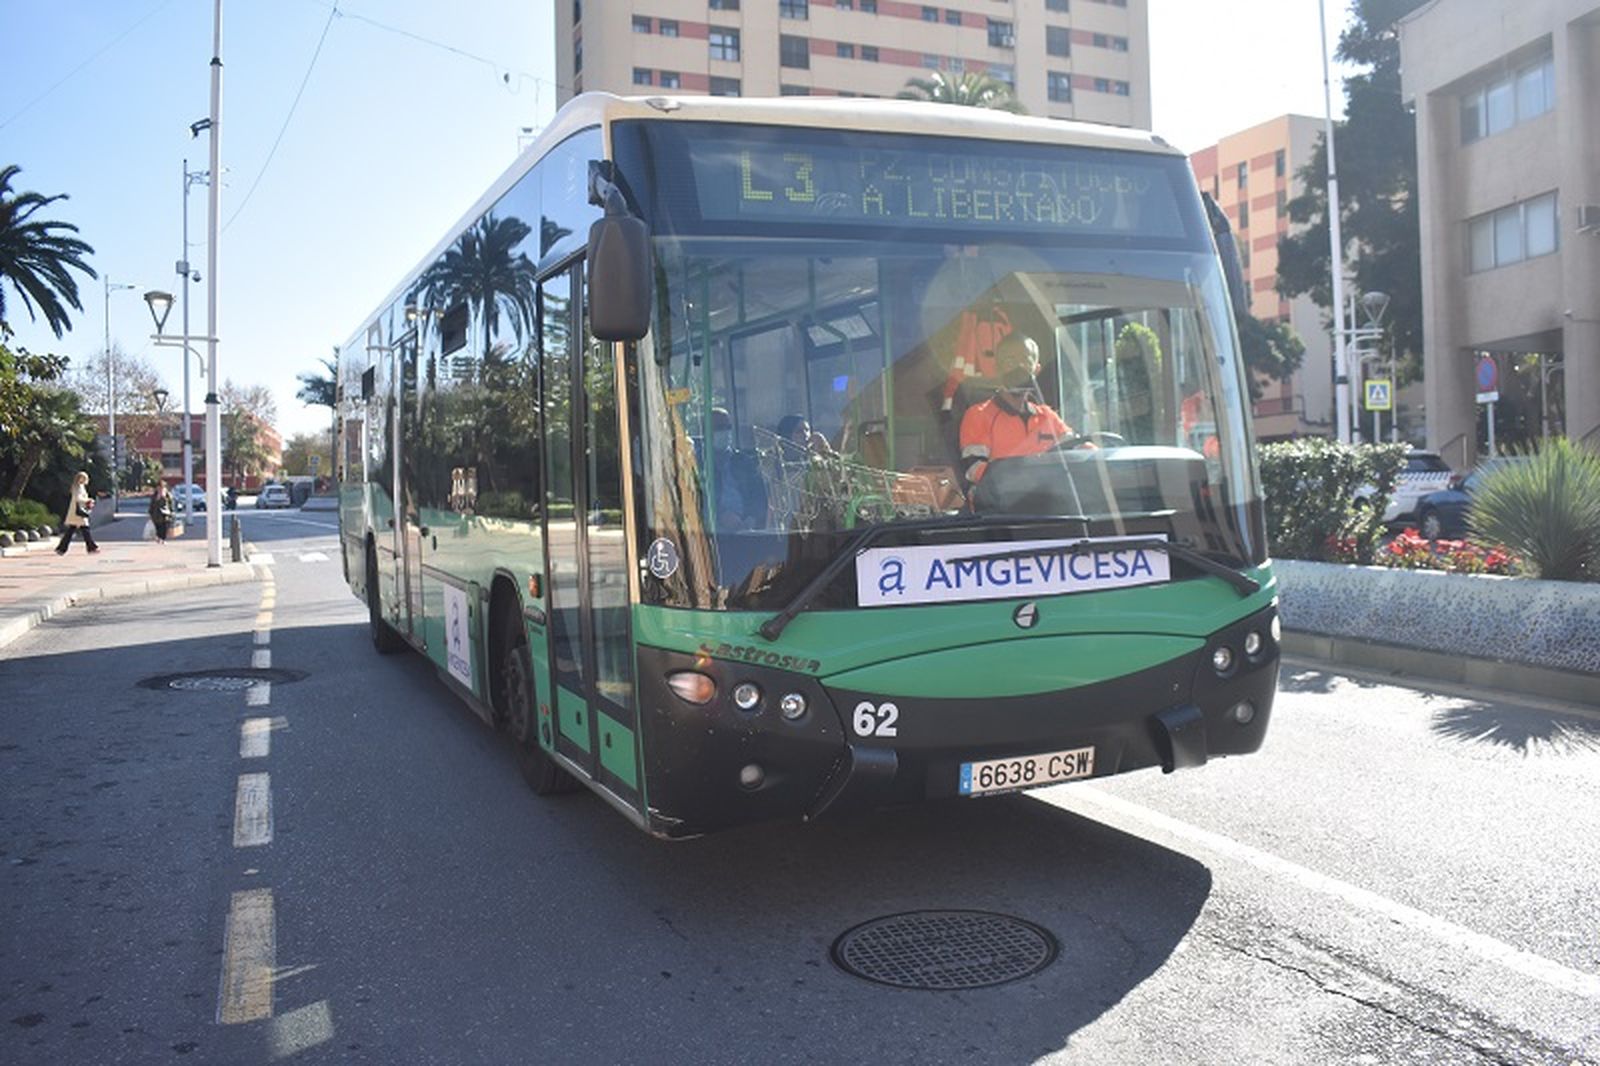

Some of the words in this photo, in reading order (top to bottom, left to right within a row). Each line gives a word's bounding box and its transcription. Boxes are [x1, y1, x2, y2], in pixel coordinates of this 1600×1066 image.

[741, 152, 815, 202] L3
[925, 549, 1153, 590] AMGEVICESA
[853, 701, 899, 737] 62
[979, 759, 1036, 788] 6638
[1047, 752, 1090, 778] CSW
